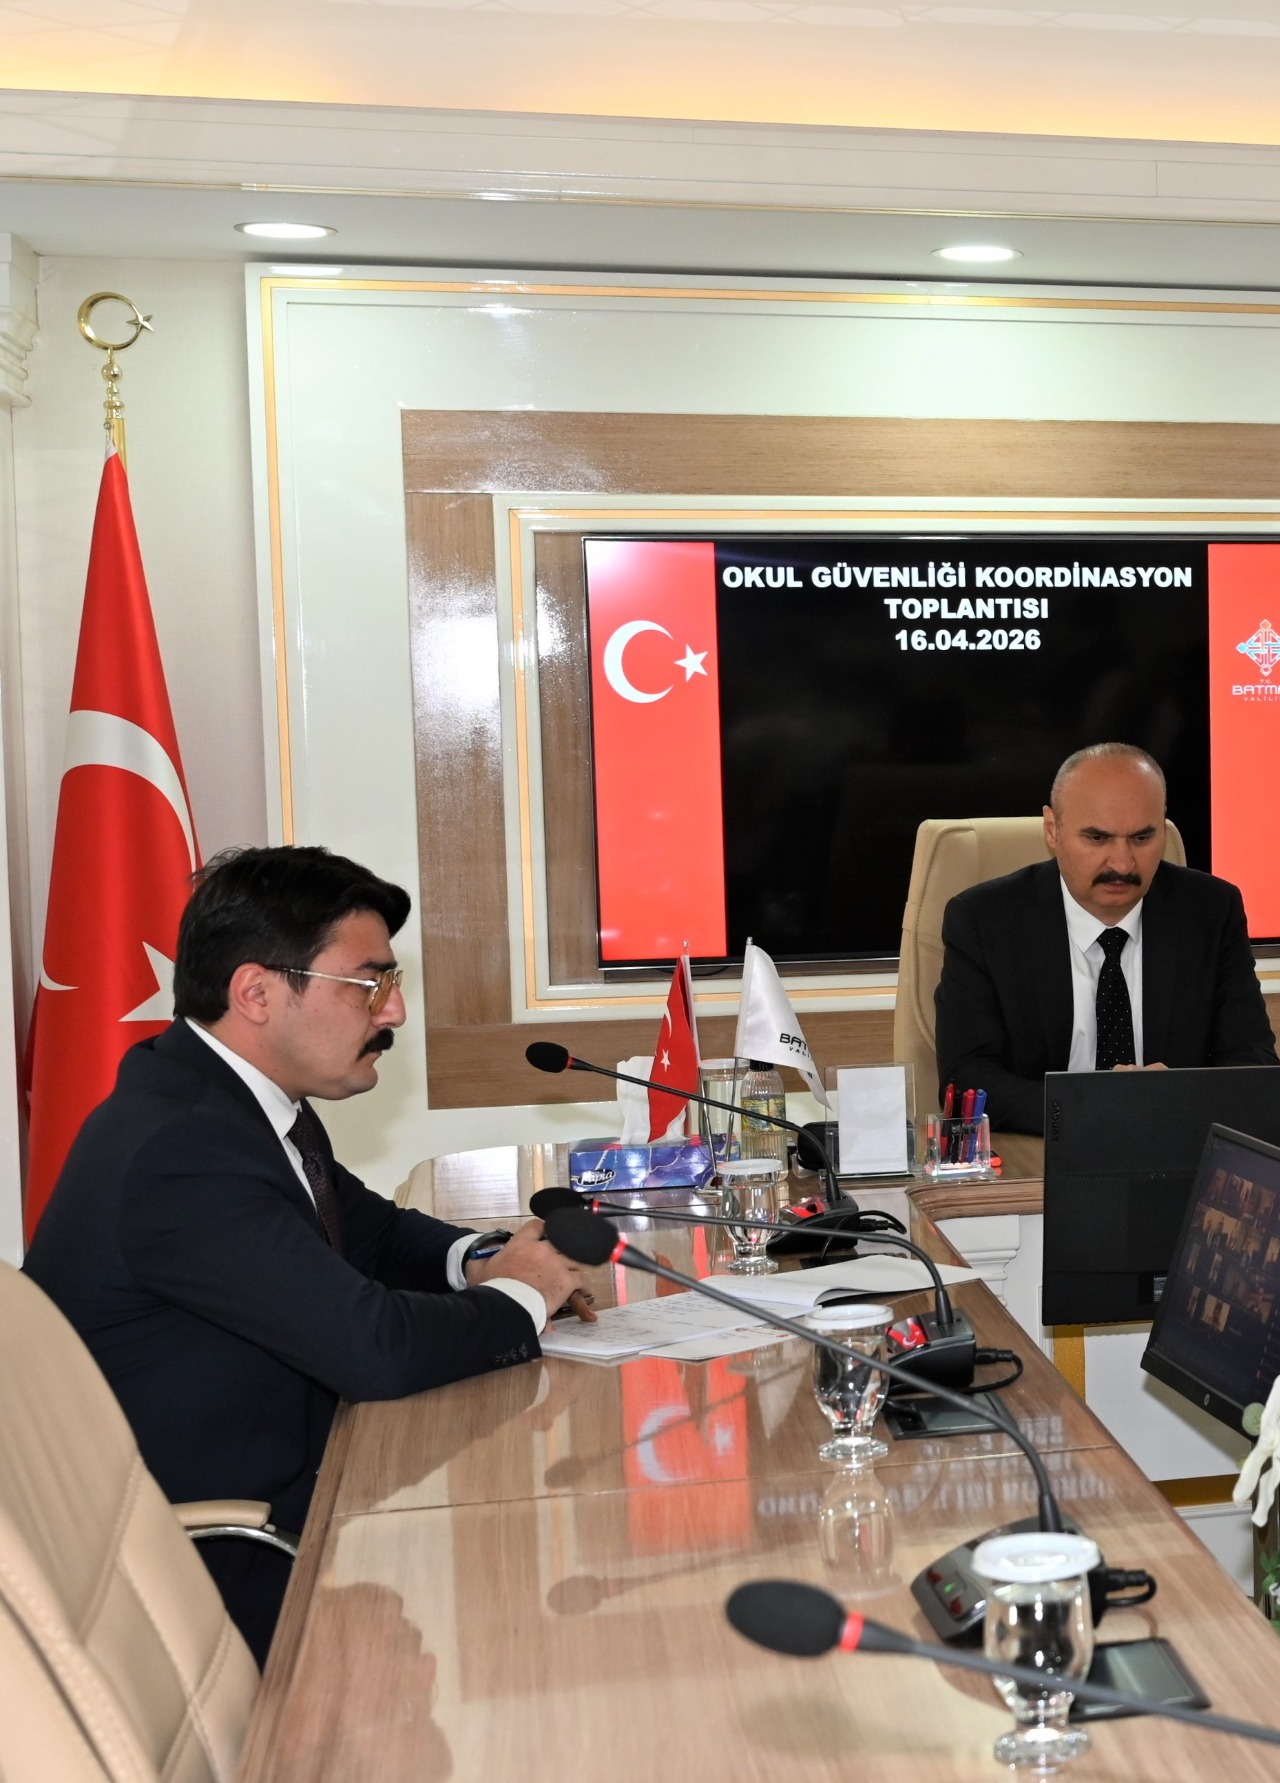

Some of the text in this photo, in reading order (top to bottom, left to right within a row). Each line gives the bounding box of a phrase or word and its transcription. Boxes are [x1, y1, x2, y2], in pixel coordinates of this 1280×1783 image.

[722, 562, 1192, 588] OKUL GÜVENLİĞİ KOORDİNASYON
[884, 598, 1049, 619] TOPLANTISI
[895, 629, 1041, 651] 16.04.2026
[779, 1032, 807, 1051] BAT
[1050, 1100, 1060, 1142] Lenovo
